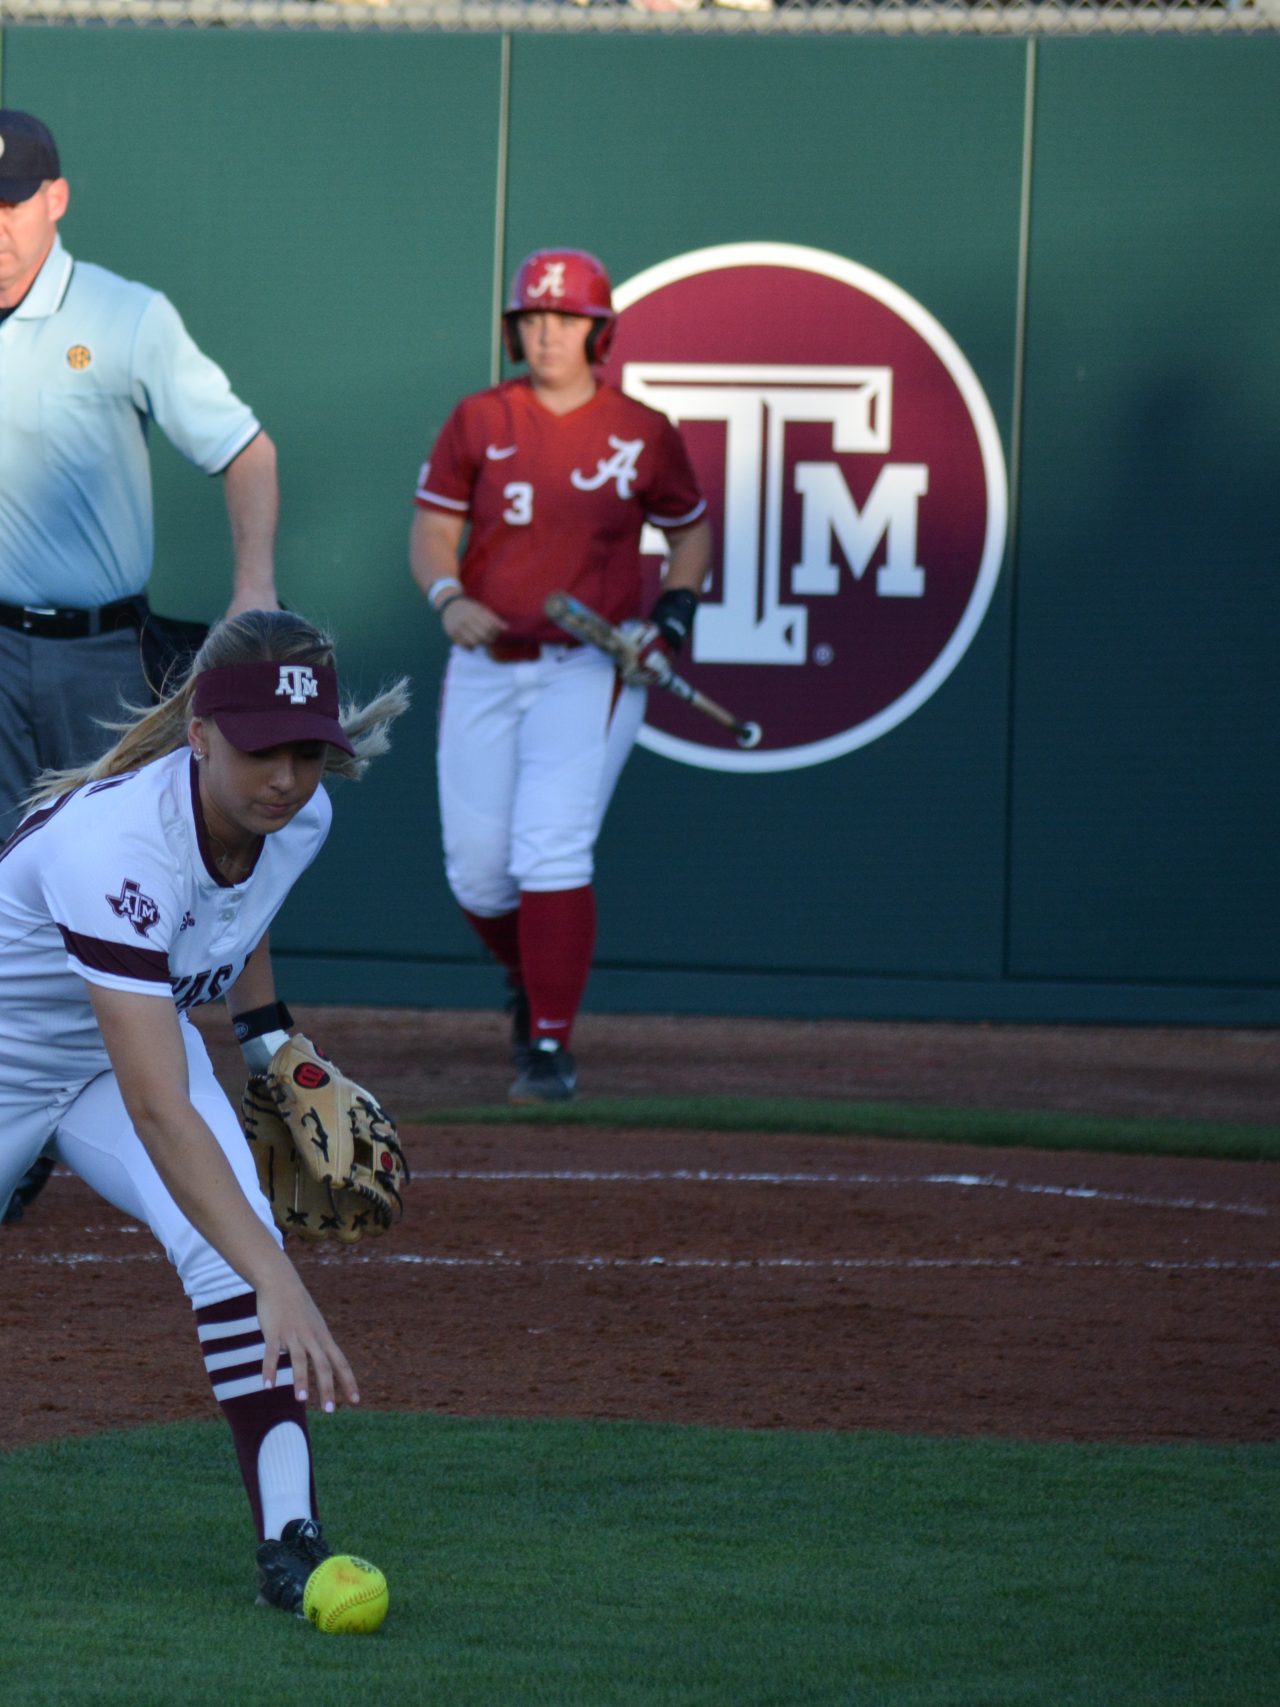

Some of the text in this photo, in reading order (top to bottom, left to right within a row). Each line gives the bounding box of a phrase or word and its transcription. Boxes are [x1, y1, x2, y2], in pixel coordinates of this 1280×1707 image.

[527, 262, 565, 298] A
[570, 434, 645, 500] A
[503, 482, 534, 526] 3
